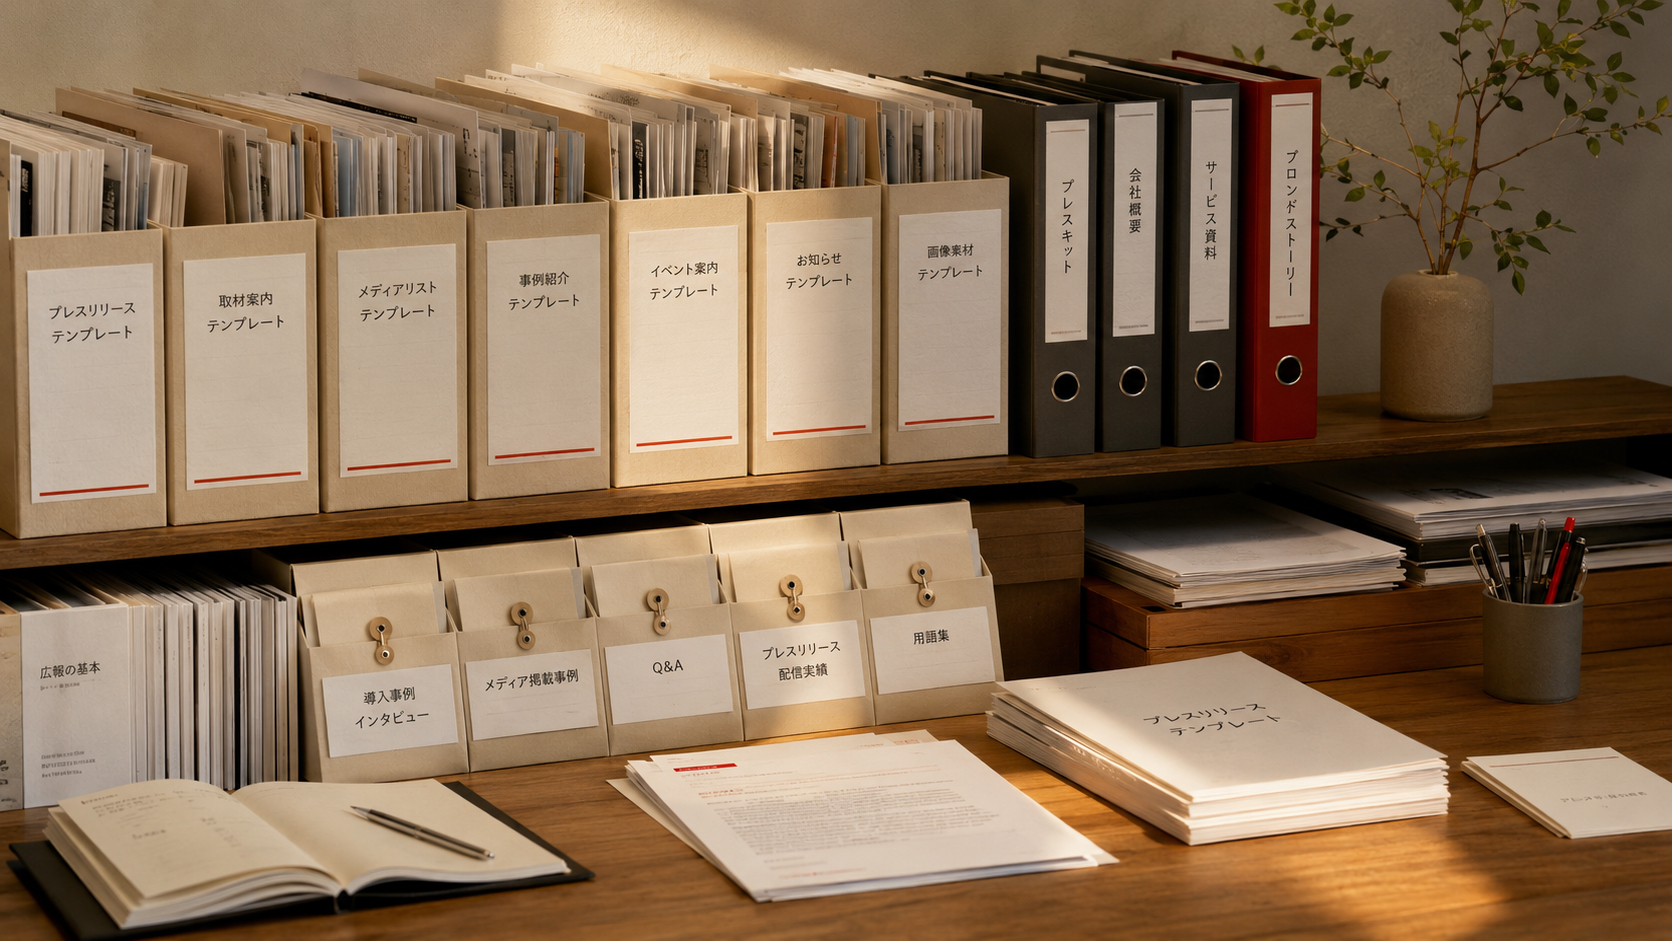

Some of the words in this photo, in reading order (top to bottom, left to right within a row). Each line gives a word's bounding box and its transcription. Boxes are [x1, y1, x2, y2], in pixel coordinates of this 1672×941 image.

[1204, 160, 1218, 261] サービス資料
[1061, 178, 1075, 274] プレスキット
[797, 252, 842, 267] お知らせ
[650, 261, 719, 278] イベント案内
[917, 264, 983, 282] テンプレート
[518, 271, 570, 288] 事例紹介
[786, 273, 853, 290] テンプレート
[358, 280, 437, 299] メディアリスト
[649, 283, 718, 301] テンプレート
[218, 291, 273, 309] 取材案内
[508, 293, 580, 311] テンプレート
[48, 302, 136, 320] プレスリリース
[360, 304, 435, 322] テンプレート
[207, 314, 284, 334] テンプレート
[51, 325, 133, 344] テンプレート
[913, 629, 950, 645] 用語集
[762, 641, 841, 661] プレスリリース
[39, 660, 101, 680] 広報の基本
[652, 659, 684, 675] Q&A
[363, 686, 416, 706] 導入事例
[355, 710, 430, 729] インタビュー
[1142, 703, 1267, 725] プレスリリース
[1169, 713, 1282, 737] テンプレート
